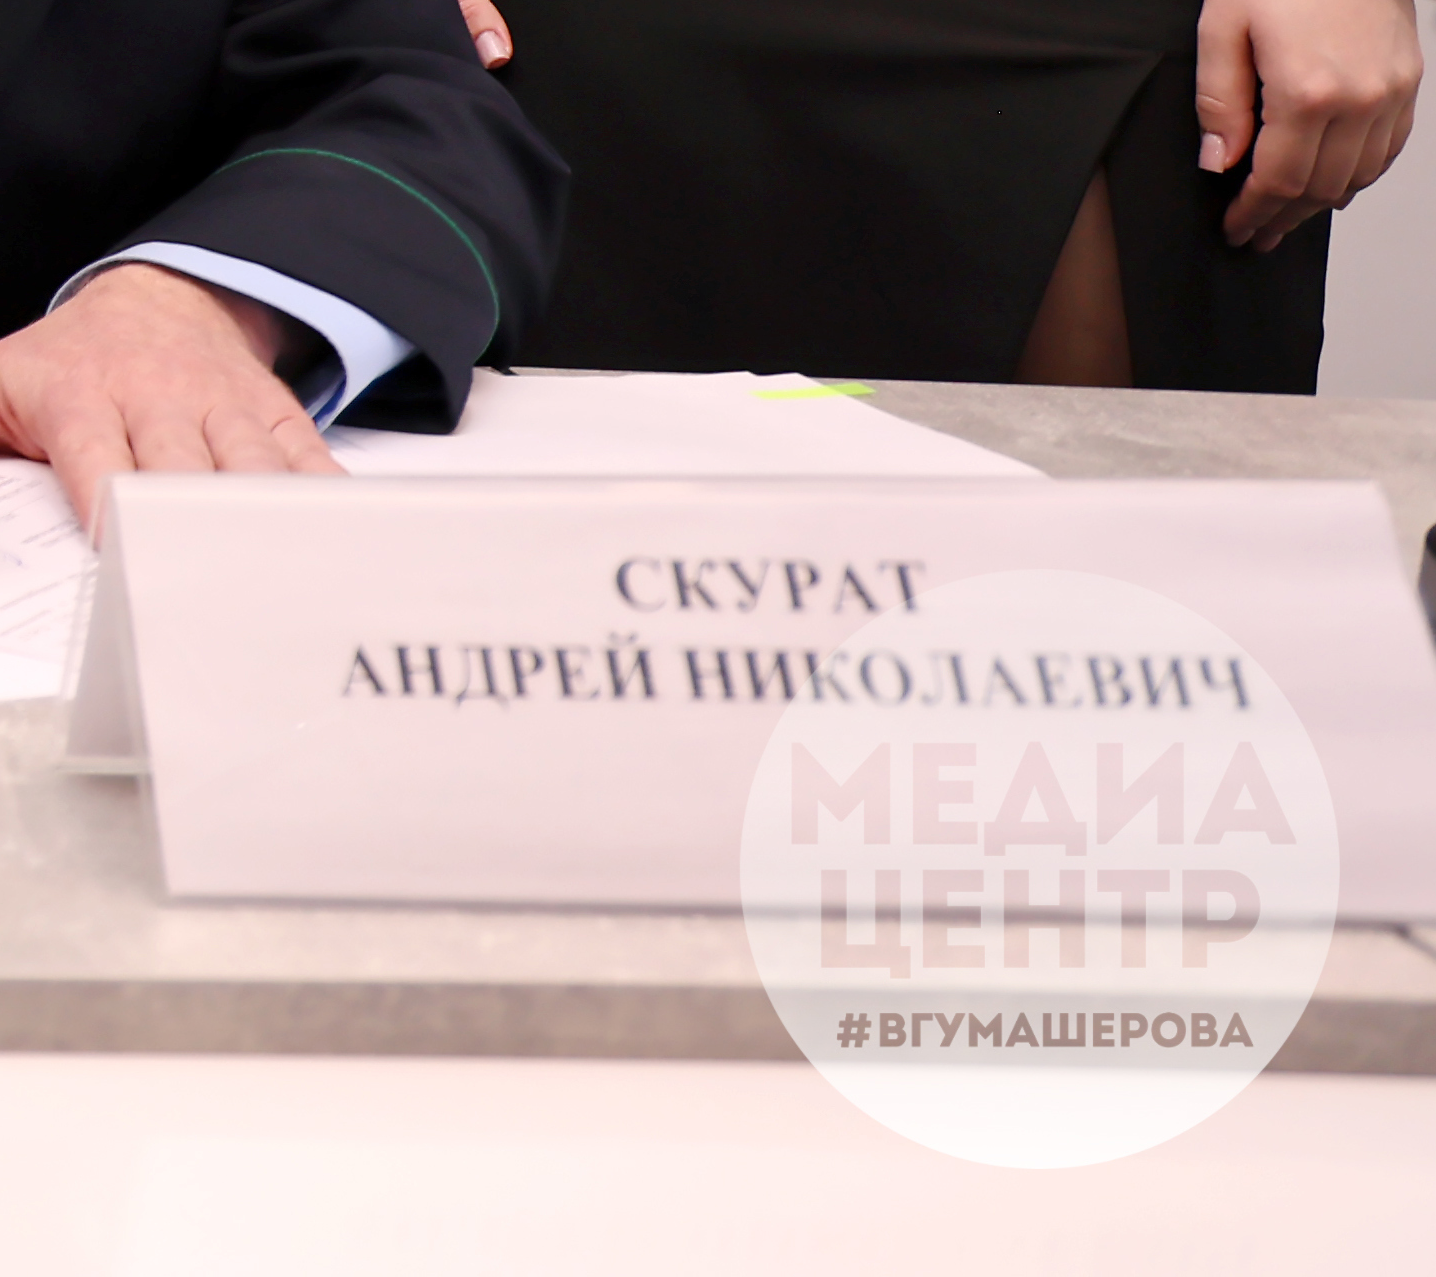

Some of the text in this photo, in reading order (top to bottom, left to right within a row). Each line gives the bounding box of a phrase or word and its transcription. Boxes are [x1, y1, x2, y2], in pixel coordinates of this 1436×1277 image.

[613, 557, 927, 615] СКУРАТ
[341, 625, 1251, 713] АНДРЕЙ НИКОЛАЕВИЧ
